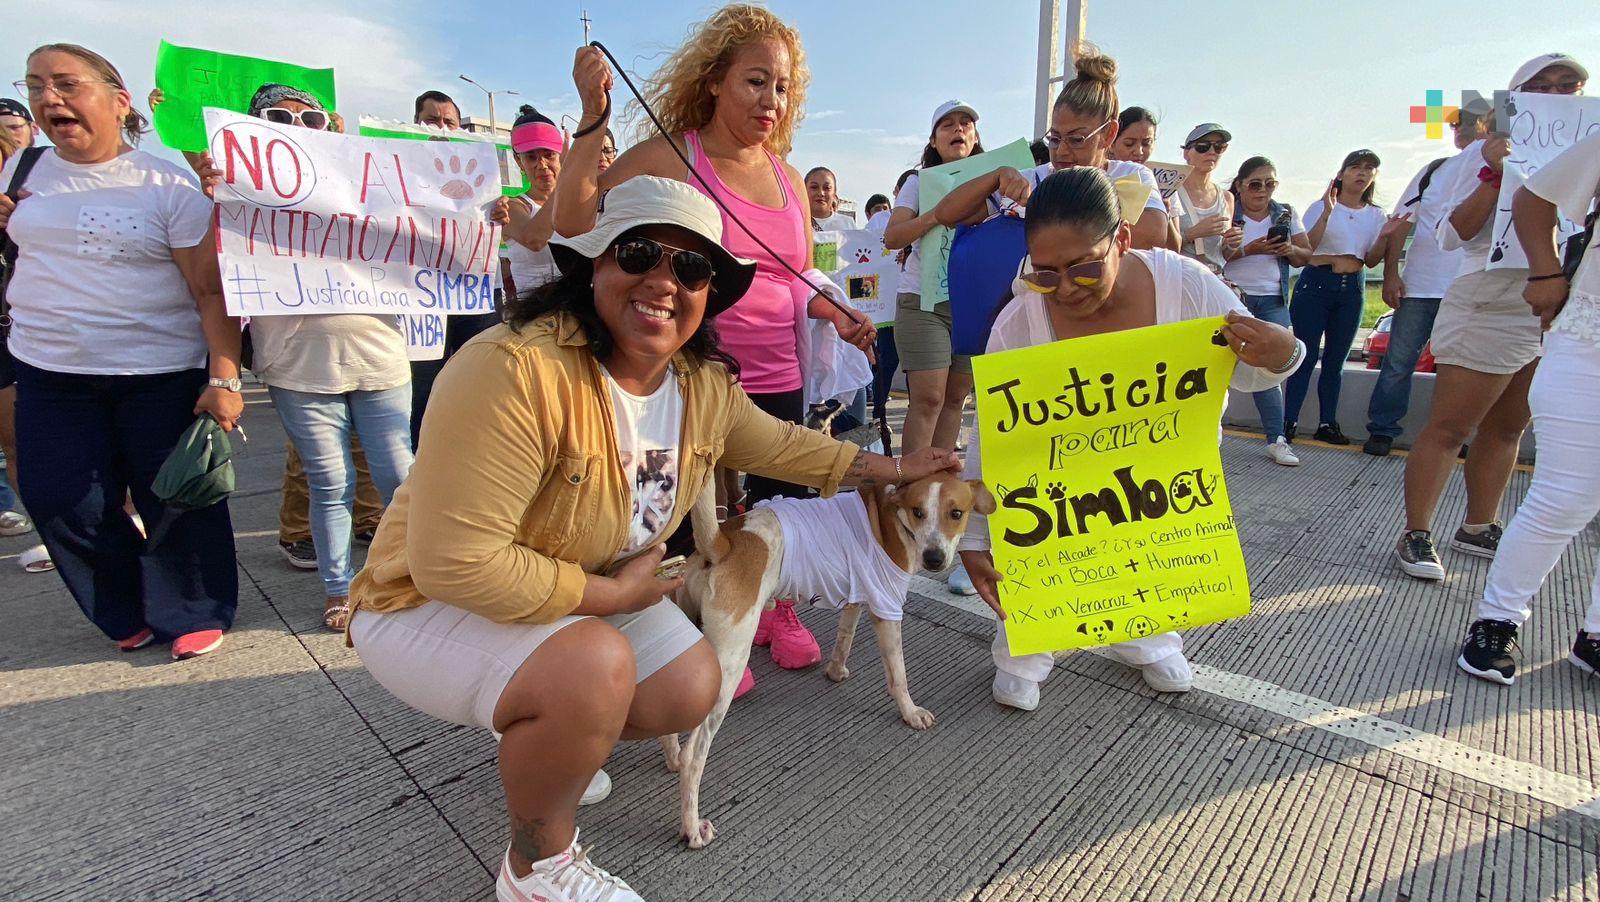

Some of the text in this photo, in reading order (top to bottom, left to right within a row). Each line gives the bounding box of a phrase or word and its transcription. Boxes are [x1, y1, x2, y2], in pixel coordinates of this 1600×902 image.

[1510, 109, 1566, 148] Que
[222, 128, 426, 207] NO AL
[214, 202, 496, 274] MALTRATO ANIMAL
[414, 269, 496, 311] SIMBA
[987, 361, 1209, 434] Justicia
[1049, 409, 1181, 471] para
[1000, 464, 1215, 548] Simba
[1037, 553, 1051, 568] el
[1150, 526, 1192, 545] Centro
[1041, 572, 1063, 588] un
[1070, 563, 1117, 585] Boca
[1146, 549, 1222, 571] Humano!
[1044, 605, 1064, 620] un
[1066, 594, 1130, 616] Veracruz
[1154, 575, 1236, 603] Empático!
